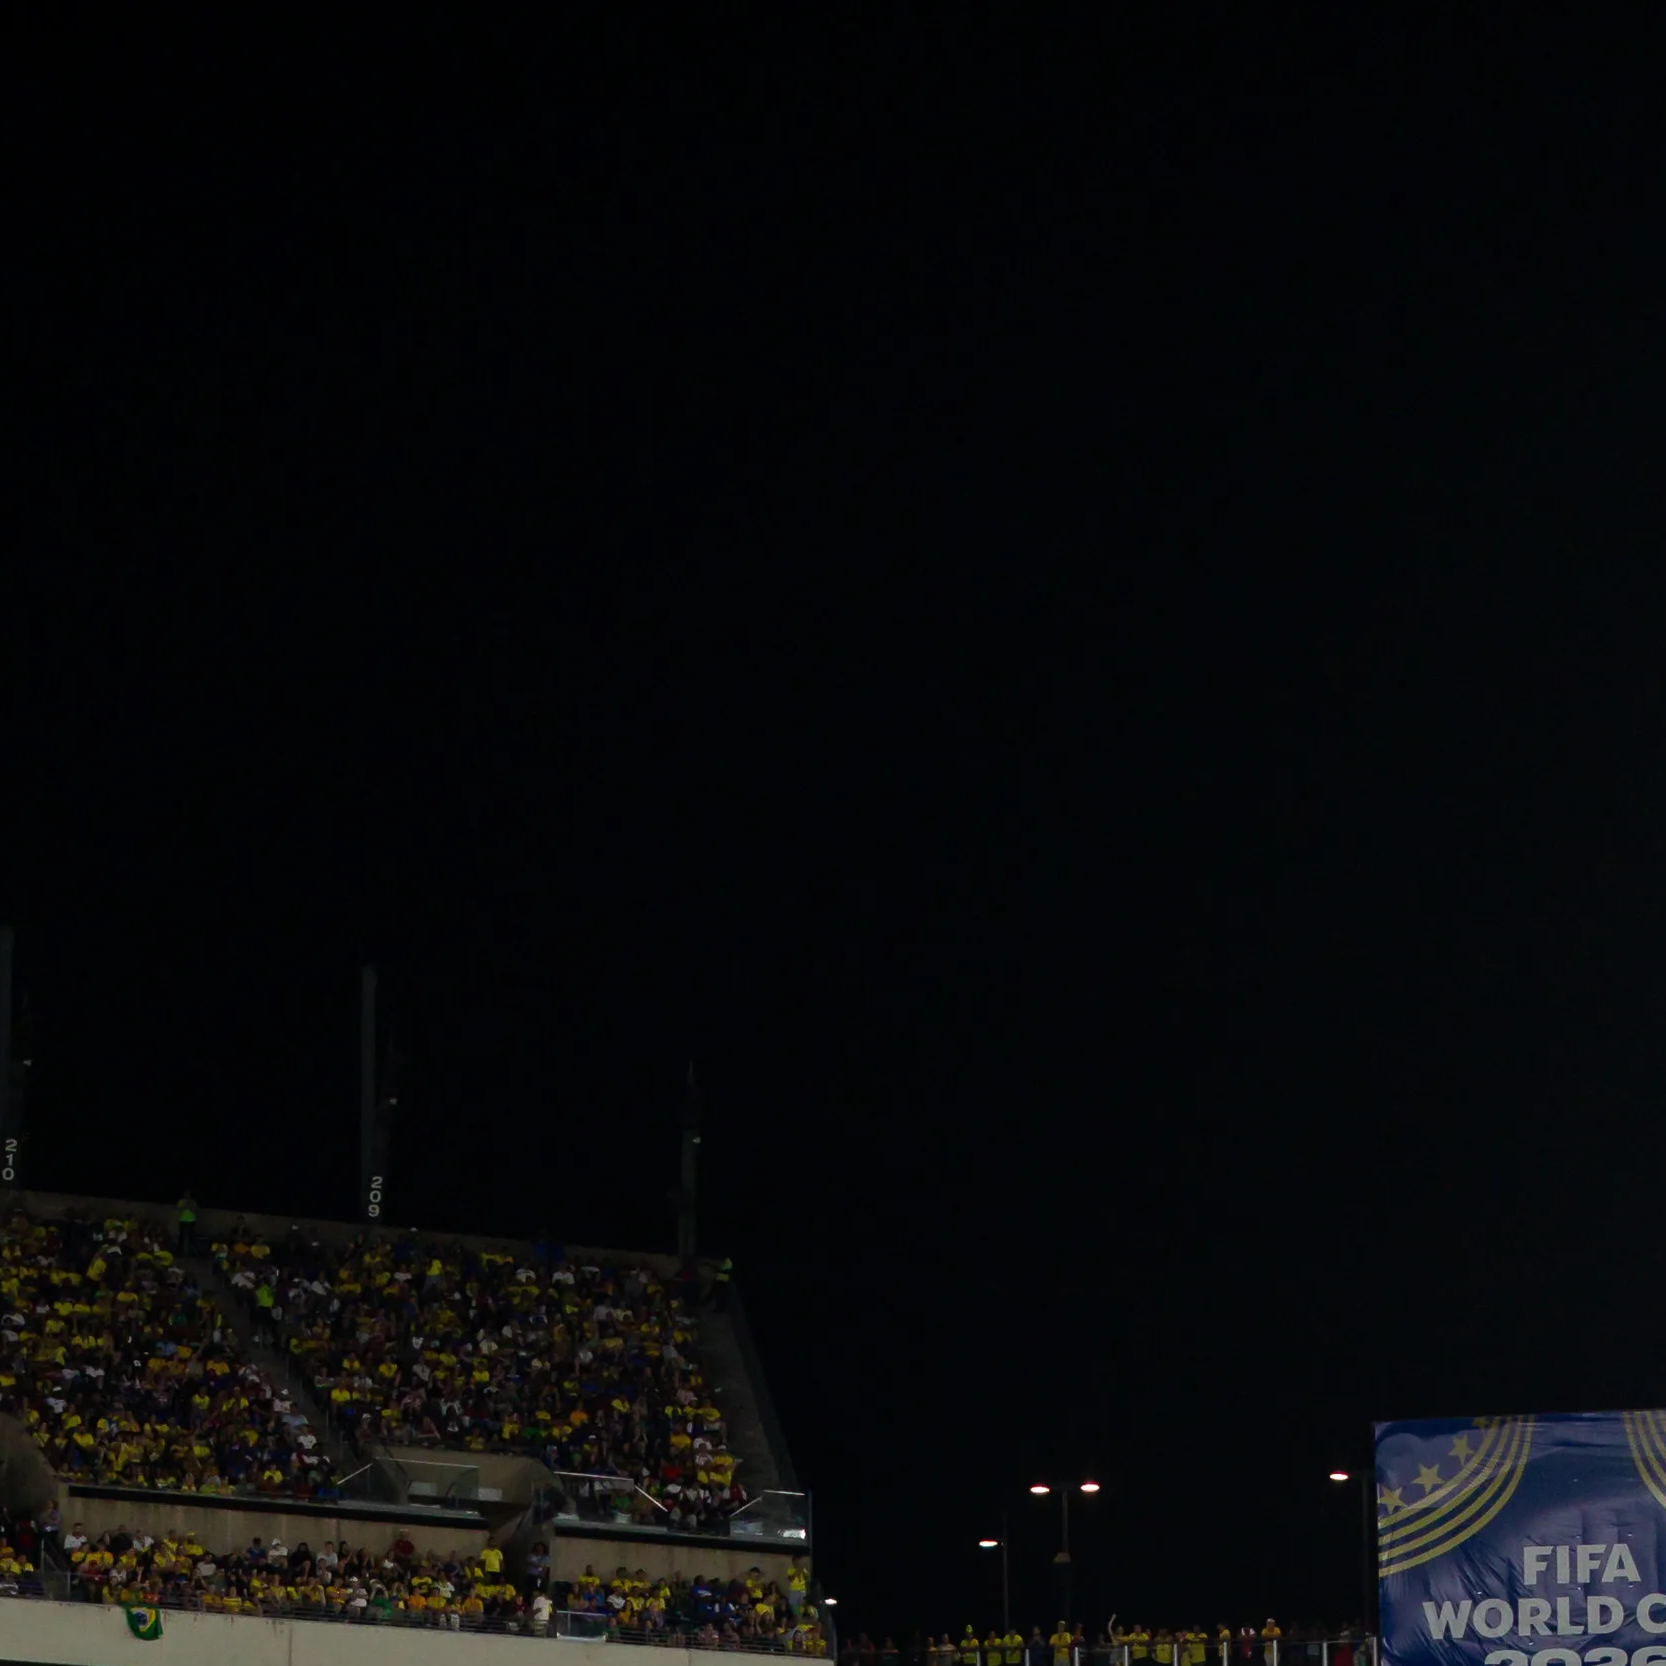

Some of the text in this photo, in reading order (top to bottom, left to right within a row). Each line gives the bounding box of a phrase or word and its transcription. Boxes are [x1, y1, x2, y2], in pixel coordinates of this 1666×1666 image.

[1, 1138, 18, 1181] 210
[367, 1175, 383, 1217] 209
[1523, 1543, 1641, 1586] FIFA
[1422, 1597, 1623, 1640] WORLD
